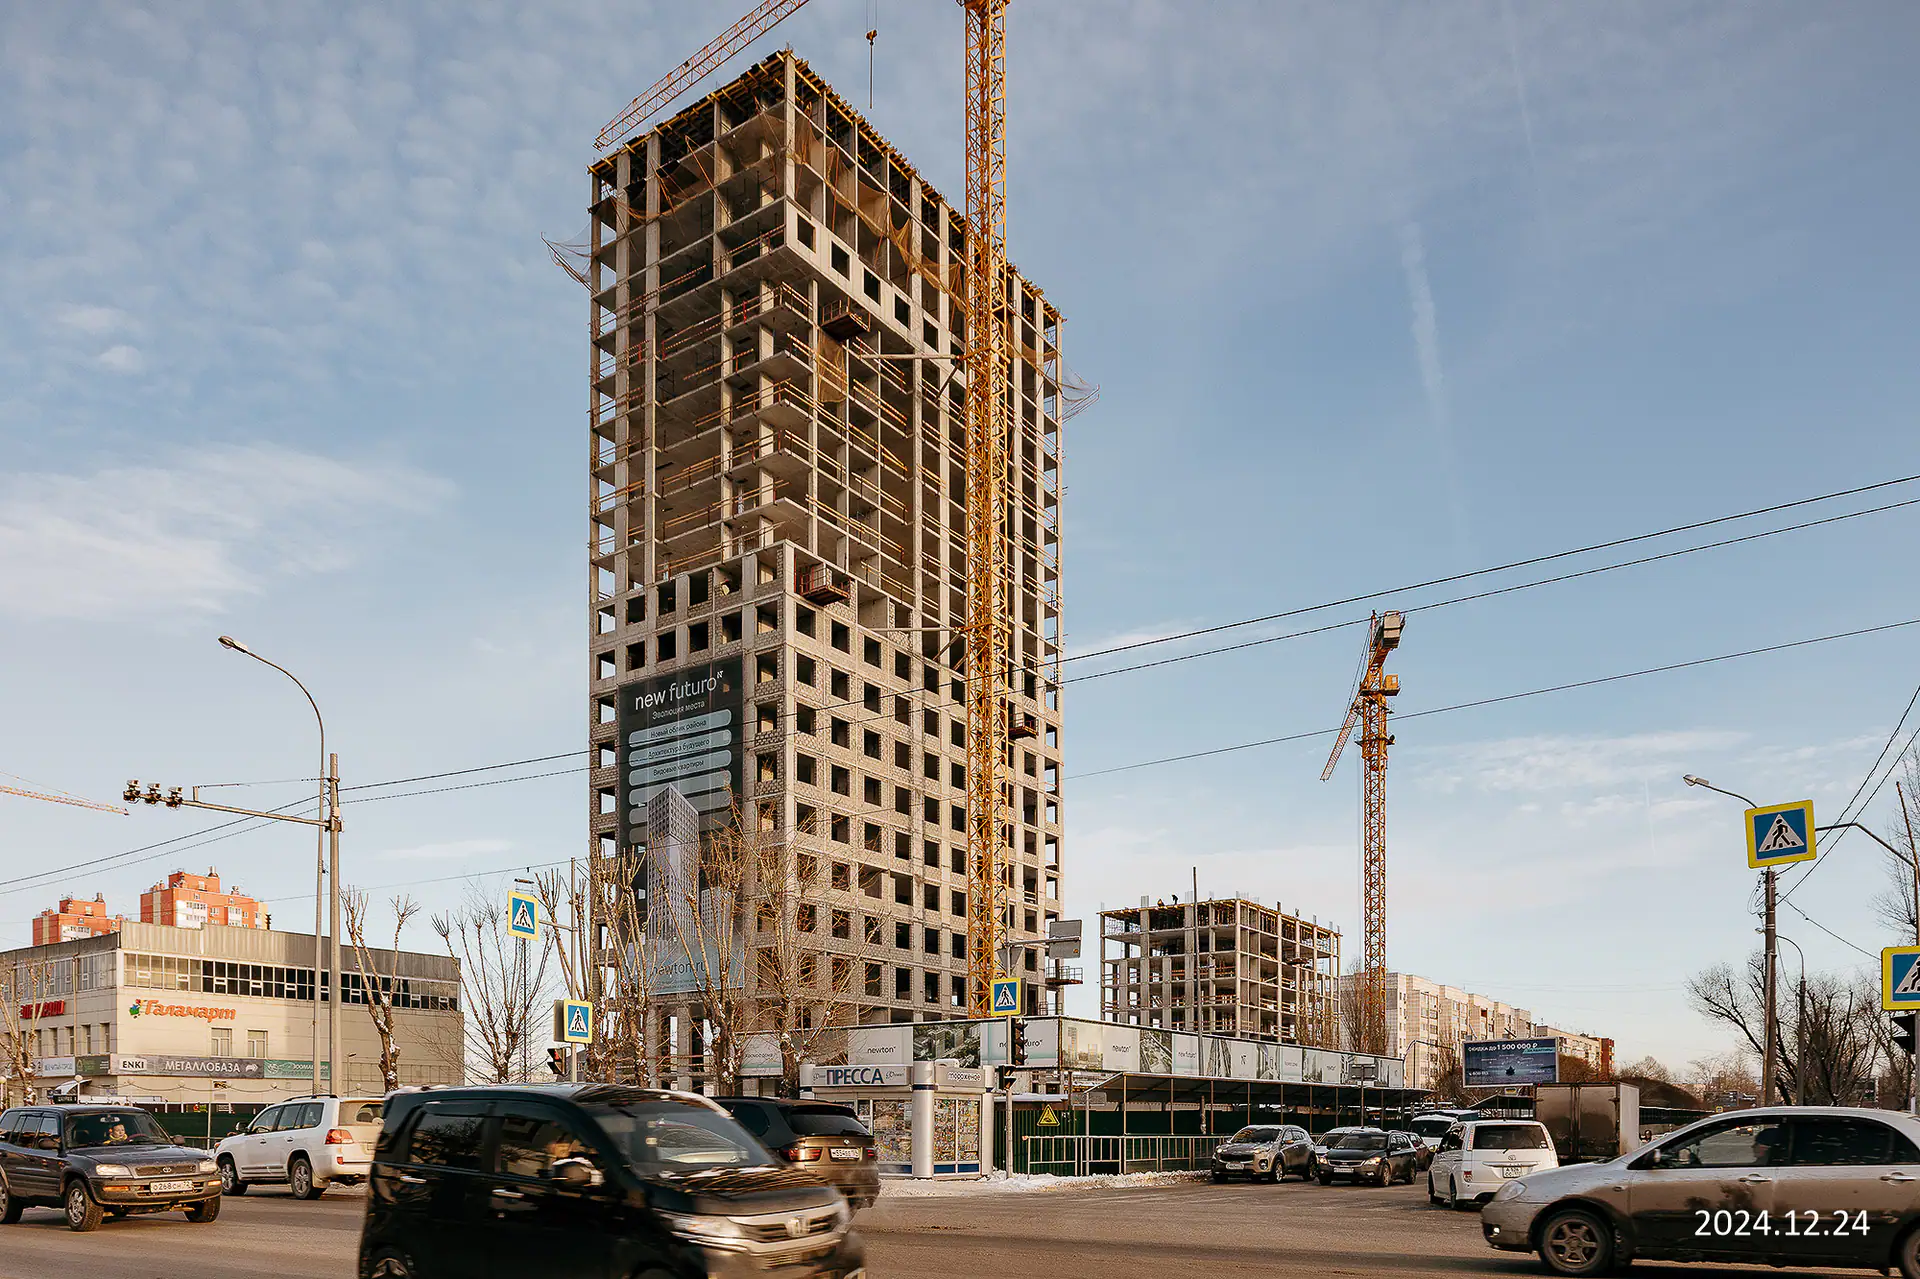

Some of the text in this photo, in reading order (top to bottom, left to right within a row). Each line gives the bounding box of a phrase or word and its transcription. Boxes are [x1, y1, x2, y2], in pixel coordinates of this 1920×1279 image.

[635, 677, 717, 710] new futuro
[652, 700, 705, 720] Эволюция места
[651, 728, 668, 738] Новый
[685, 720, 707, 731] района
[653, 767, 677, 777] Видовые
[145, 1000, 237, 1023] Галамарт
[867, 1046, 894, 1054] newton
[122, 1060, 144, 1069] ENKI
[165, 1060, 241, 1073] МЕТАЛЛОБАЗА
[826, 1068, 885, 1085] ПРЕССА
[947, 1071, 982, 1082] мороженое
